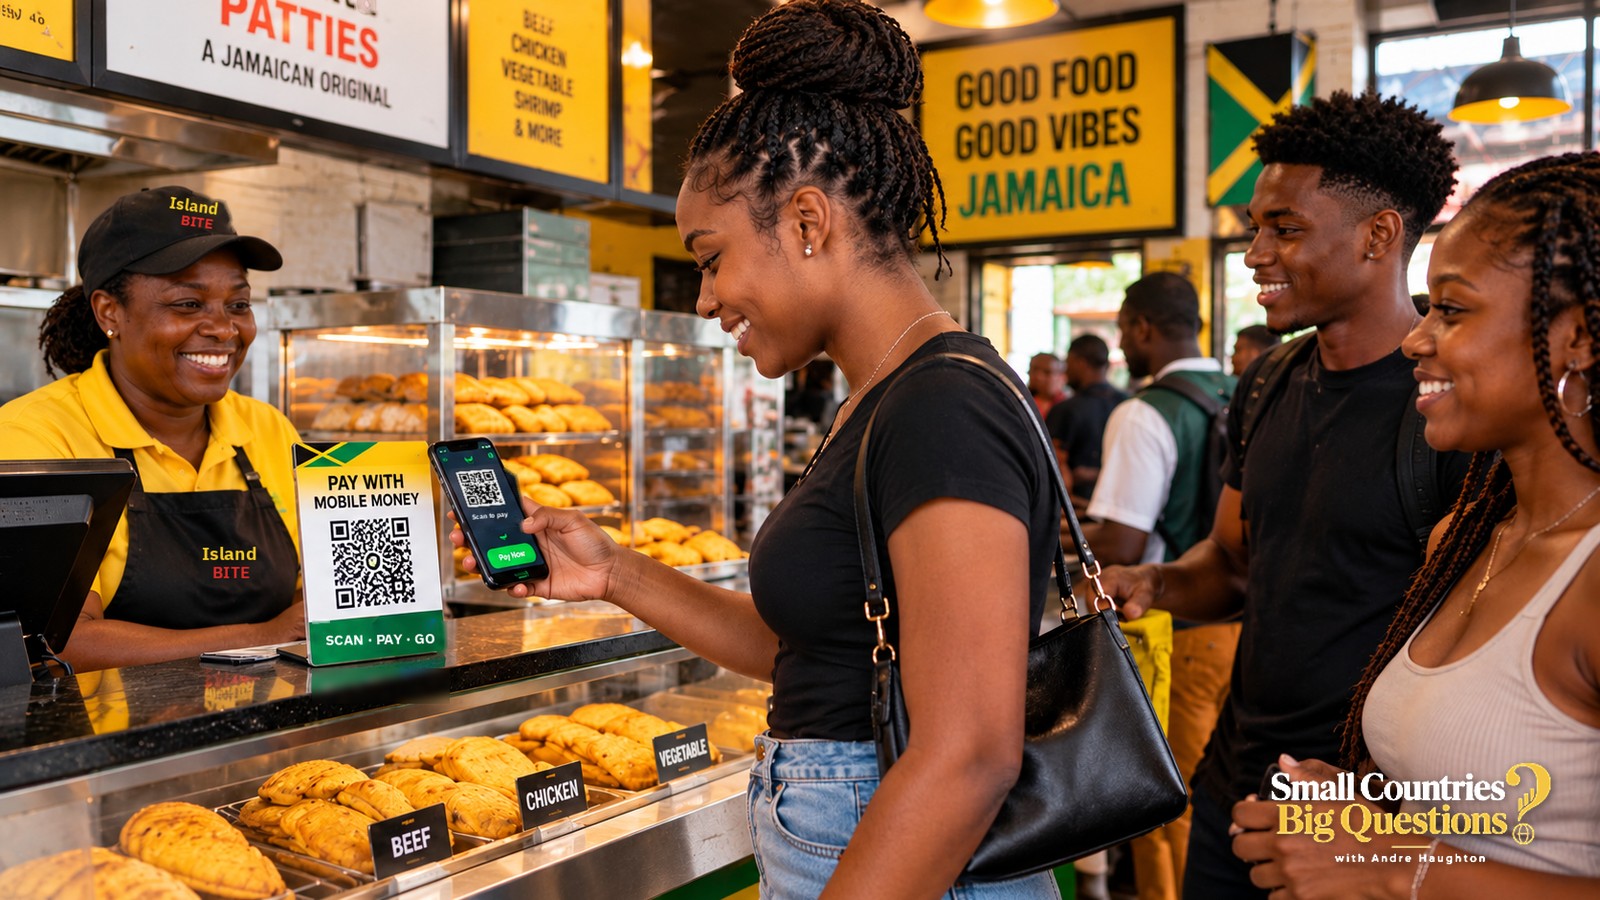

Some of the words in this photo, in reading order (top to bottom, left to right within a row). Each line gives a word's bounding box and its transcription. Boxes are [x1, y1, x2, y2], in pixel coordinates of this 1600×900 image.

[221, 0, 379, 69] PATTIES
[523, 9, 554, 35] BEEF
[511, 33, 567, 69] CHICKEN
[202, 39, 215, 64] A
[221, 44, 314, 89] JAMAICAN
[320, 71, 392, 109] ORIGINAL
[501, 58, 573, 98] VEGETABLE
[956, 64, 1039, 110] GOOD
[1052, 52, 1137, 98] FOOD
[514, 90, 562, 118] SHRIMP
[514, 118, 523, 137] &
[528, 121, 563, 148] MORE
[955, 116, 1038, 161] GOOD
[1048, 105, 1141, 151] VIBES
[958, 161, 1131, 219] JAMAICA
[169, 196, 219, 215] Island
[181, 215, 213, 229] BITE
[328, 475, 359, 490] PAY
[362, 473, 404, 489] WITH
[314, 495, 367, 510] MOBILE
[371, 492, 420, 508] MONEY
[496, 512, 509, 520] pay
[202, 546, 257, 561] Island
[213, 566, 250, 579] BITE
[325, 634, 364, 646] SCAN
[376, 634, 403, 645] PAY
[414, 633, 436, 645] GO
[659, 739, 708, 768] VEGETABLE
[526, 779, 579, 811] CHICKEN
[391, 826, 431, 858] BEEF
